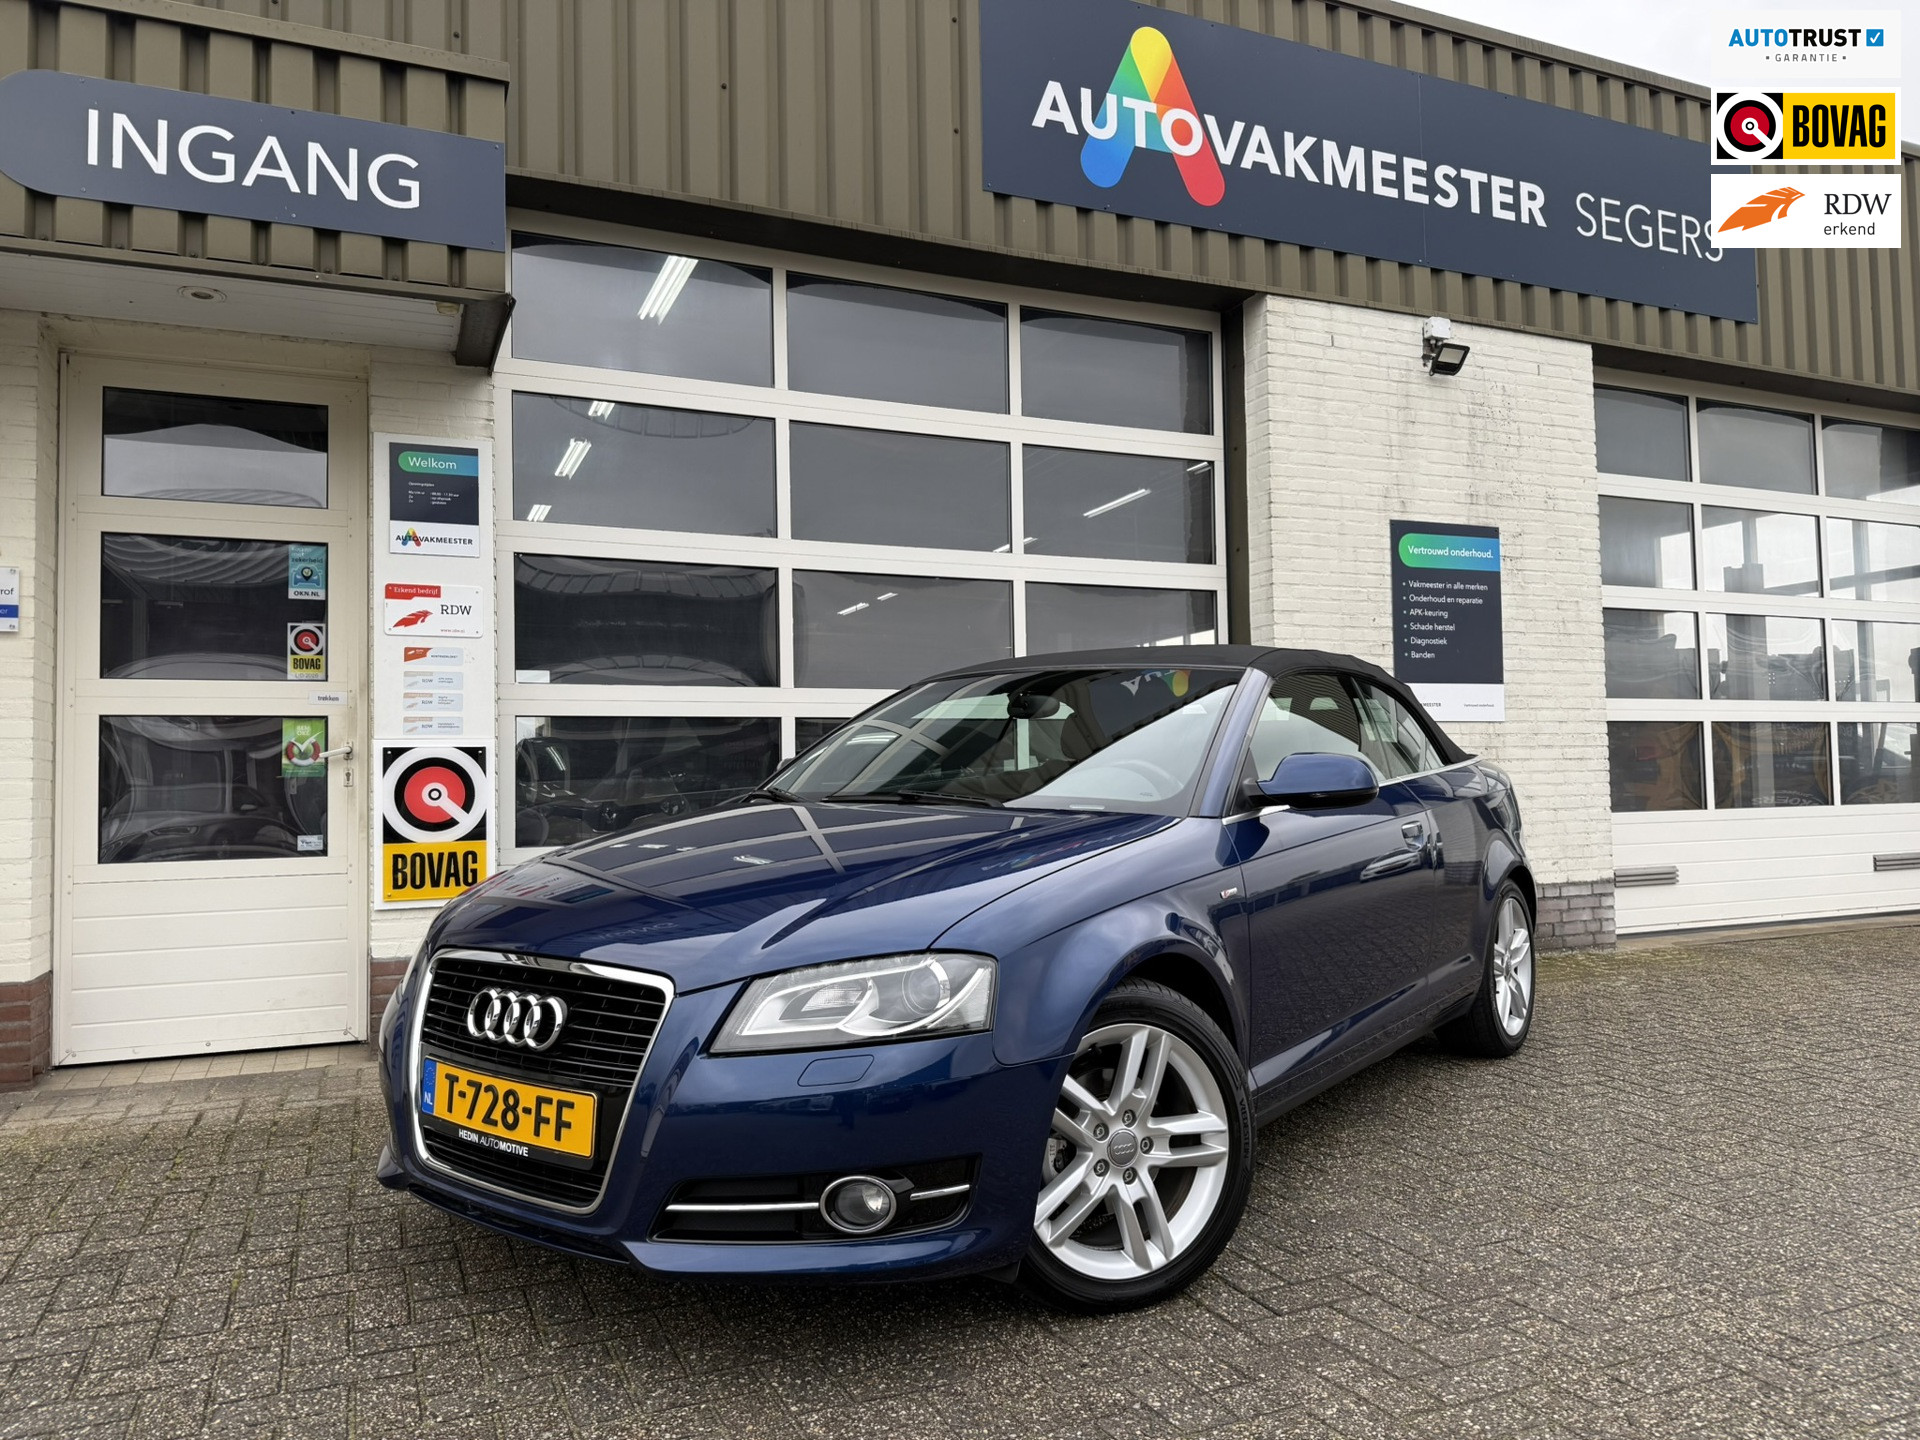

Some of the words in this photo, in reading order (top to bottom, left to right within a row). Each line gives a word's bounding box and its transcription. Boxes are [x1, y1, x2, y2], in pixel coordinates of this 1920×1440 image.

[87, 108, 420, 209] INGANG
[1031, 80, 1547, 228] AUTOVAKMEESTER
[408, 456, 457, 470] Welkom
[395, 534, 473, 545] AUTOVAKMEESTER
[1407, 544, 1449, 557] Vertrouwd
[1450, 547, 1494, 559] onderhoud.
[394, 586, 416, 594] Erkend
[1408, 580, 1446, 590] Vakmeester
[1446, 582, 1452, 590] in
[1453, 582, 1464, 590] alle
[1465, 583, 1489, 591] merken
[1409, 594, 1446, 603] Onderhoud
[1456, 596, 1483, 605] reparatie
[440, 604, 472, 616] RDW
[1409, 608, 1449, 619] APK-keuring
[1410, 623, 1434, 631] Schade
[1434, 623, 1456, 632] herstel
[1410, 637, 1448, 646] Diagnostiek
[1411, 651, 1435, 659] Banden
[293, 657, 321, 670] BOVAG
[392, 850, 478, 891] BOVAG
[424, 1091, 433, 1106] NL
[444, 1072, 575, 1142] T-728-FF
[458, 1128, 479, 1143] HEDIN
[479, 1135, 529, 1157] AUTOMOTIVE
